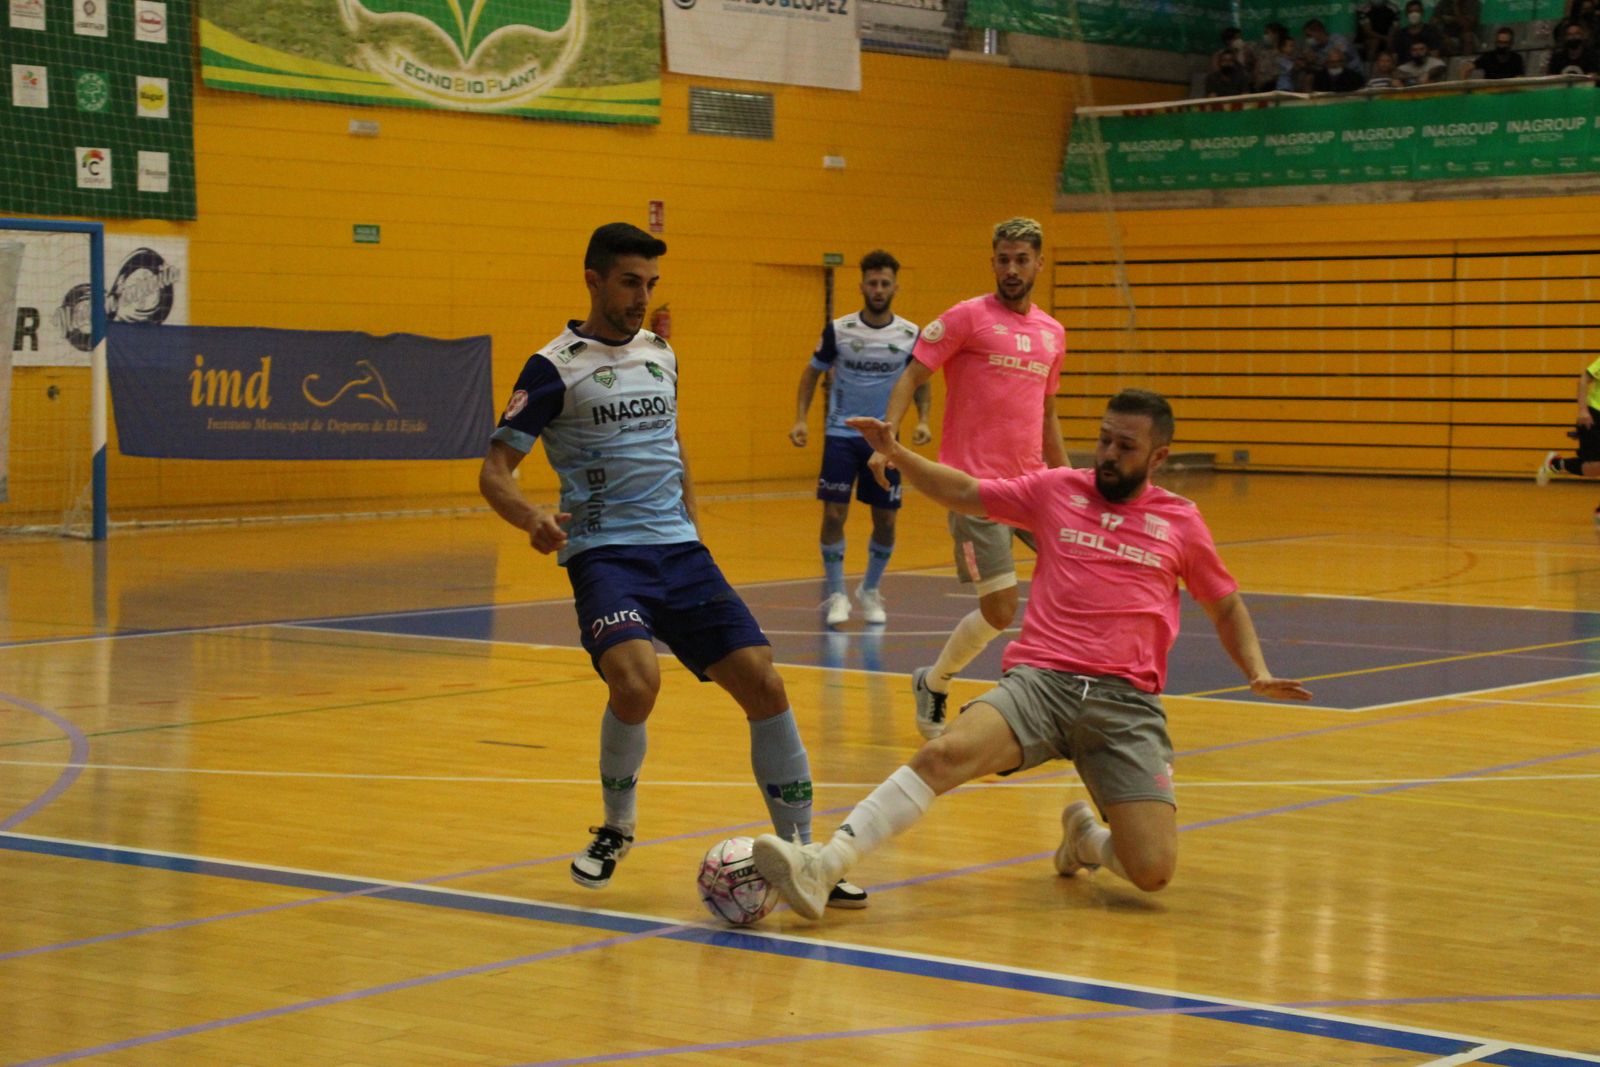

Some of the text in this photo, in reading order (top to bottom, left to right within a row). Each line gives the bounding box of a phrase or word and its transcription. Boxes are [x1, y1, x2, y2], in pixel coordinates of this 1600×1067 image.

[1422, 121, 1499, 137] INAGROUP
[1506, 117, 1586, 133] INAGROUP
[1265, 131, 1336, 147] INAGROUP
[1342, 126, 1415, 142] INAGROUP
[1118, 138, 1184, 152] INAGROUP
[1190, 136, 1258, 150] INAGROUP
[1014, 334, 1032, 352] 10
[988, 354, 1050, 377] SOLISS
[187, 354, 272, 410] imd
[1101, 512, 1124, 531] 17
[1058, 527, 1164, 568] SOLISS
